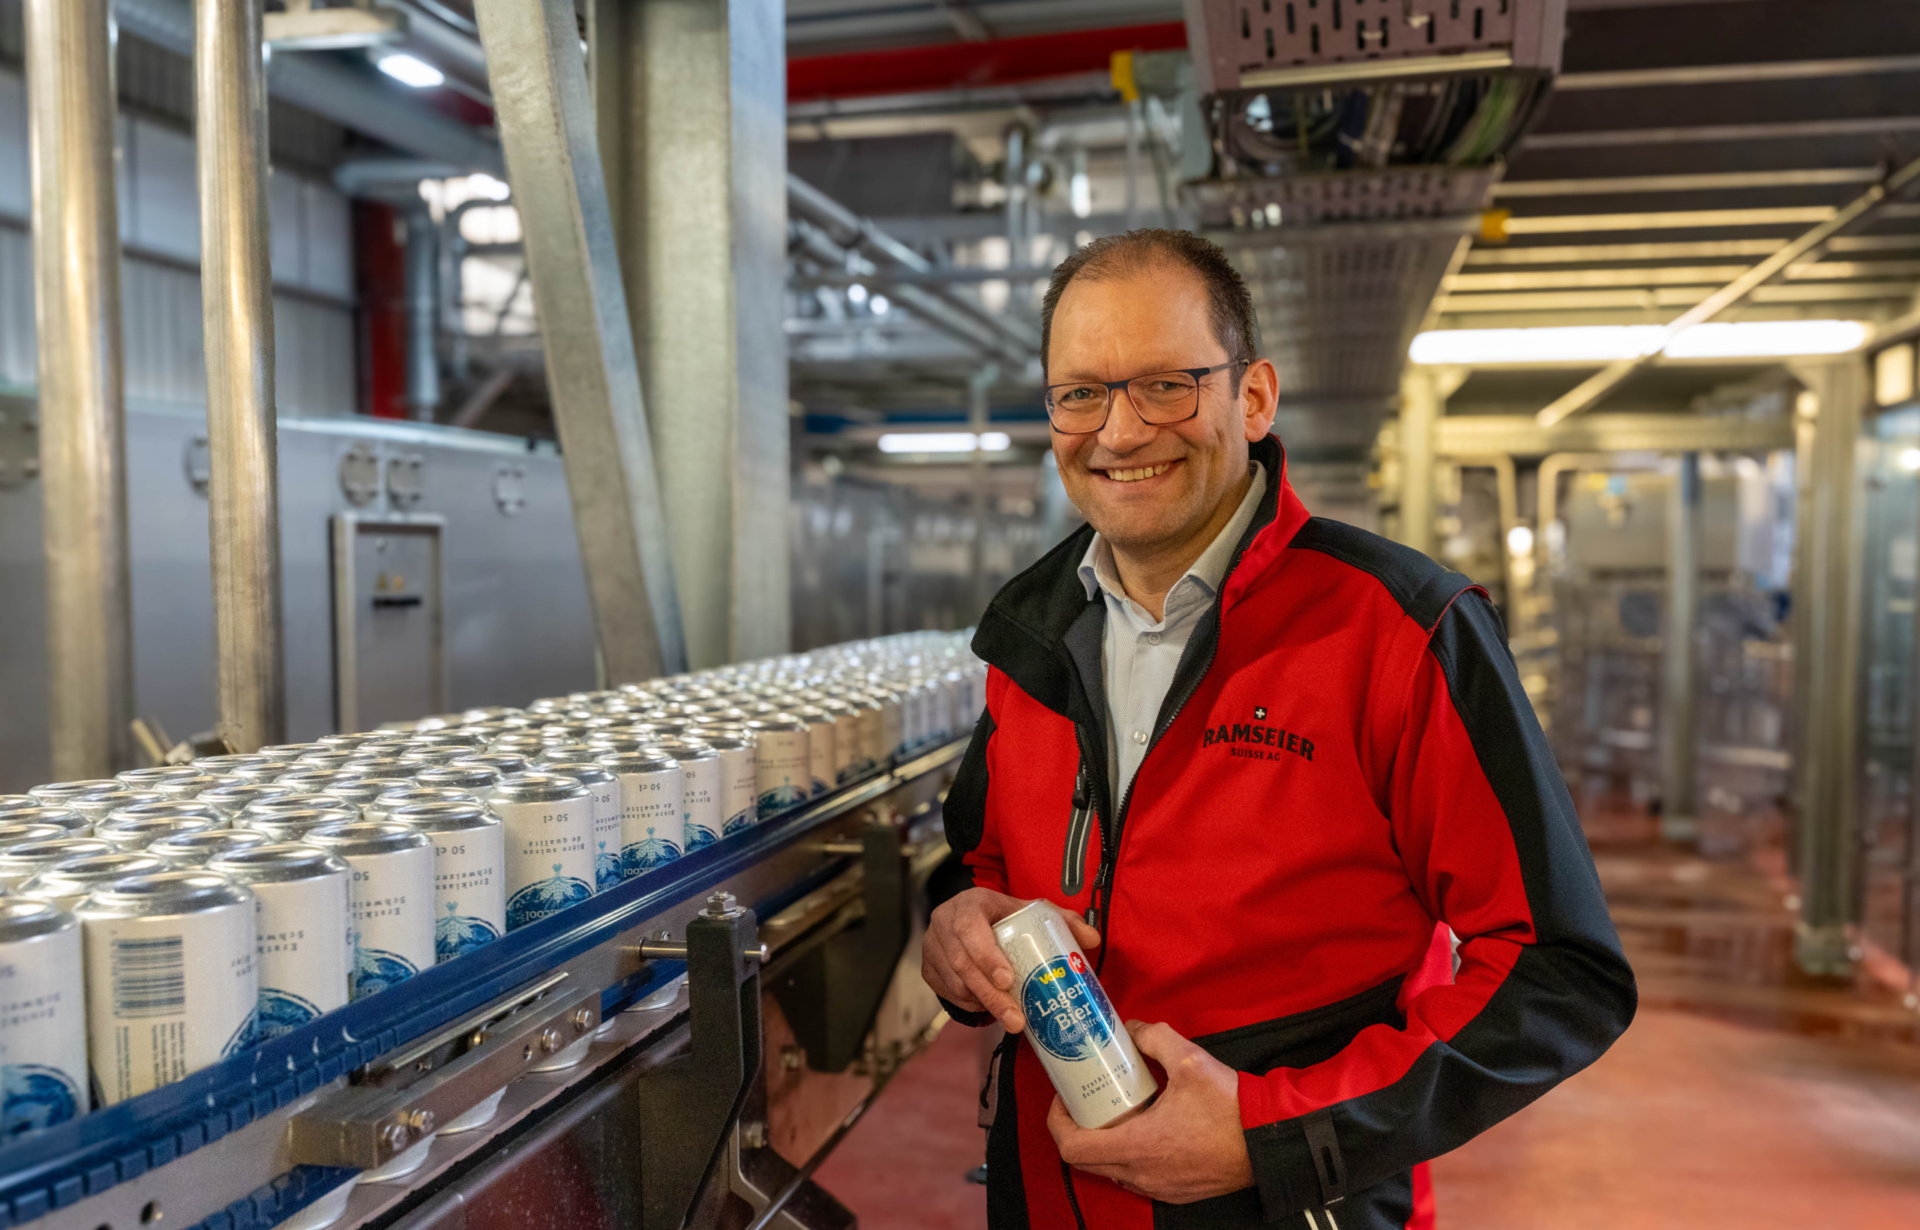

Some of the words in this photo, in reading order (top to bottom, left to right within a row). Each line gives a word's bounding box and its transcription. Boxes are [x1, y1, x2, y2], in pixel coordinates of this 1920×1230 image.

[1203, 724, 1315, 762] RAMSEIER
[1231, 748, 1264, 760] SUISSE
[1266, 752, 1281, 762] AG
[639, 784, 648, 792] cl
[651, 783, 661, 791] 50
[602, 795, 610, 803] 50
[626, 804, 660, 813] qualité
[543, 815, 553, 824] cl
[557, 814, 568, 823] 50
[528, 837, 568, 848] qualité
[572, 836, 581, 844] de
[452, 845, 466, 855] 50
[523, 847, 557, 855] suisse
[562, 843, 585, 853] Bière
[353, 871, 370, 882] 50
[1053, 1001, 1092, 1031] Bier
[1111, 1096, 1122, 1106] 50
